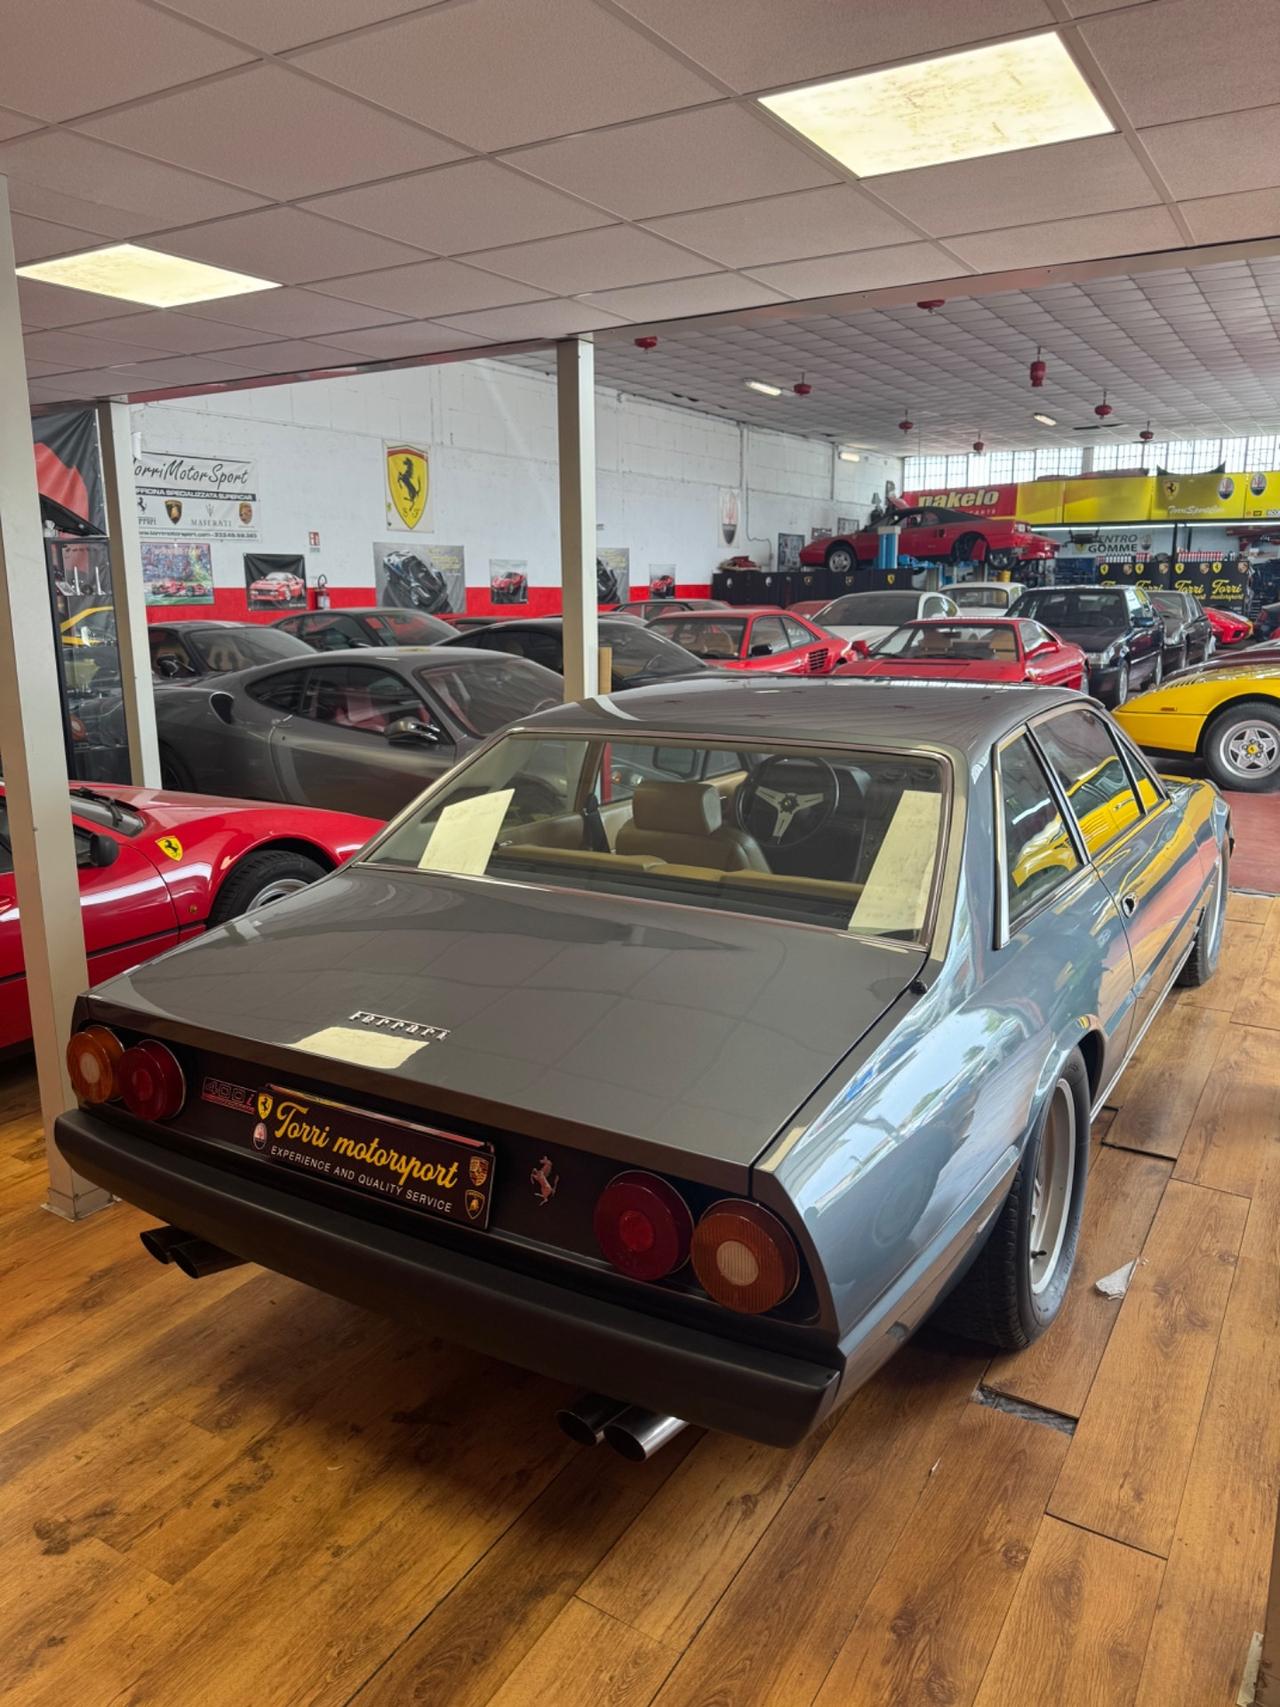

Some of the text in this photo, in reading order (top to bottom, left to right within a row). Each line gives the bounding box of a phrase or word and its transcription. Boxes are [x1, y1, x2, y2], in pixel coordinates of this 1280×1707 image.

[133, 457, 248, 490] orriMotorSport
[191, 518, 232, 527] MASERATI
[1098, 534, 1138, 544] ENTRO
[1088, 543, 1138, 553] GOMME
[1175, 579, 1204, 593] Torri
[1211, 579, 1242, 594] Torri
[348, 1010, 451, 1040] Ferrari
[275, 1101, 459, 1189] Torri motorsport
[270, 1145, 452, 1213] EXPERIENCE AND QUALITY SERVICE
